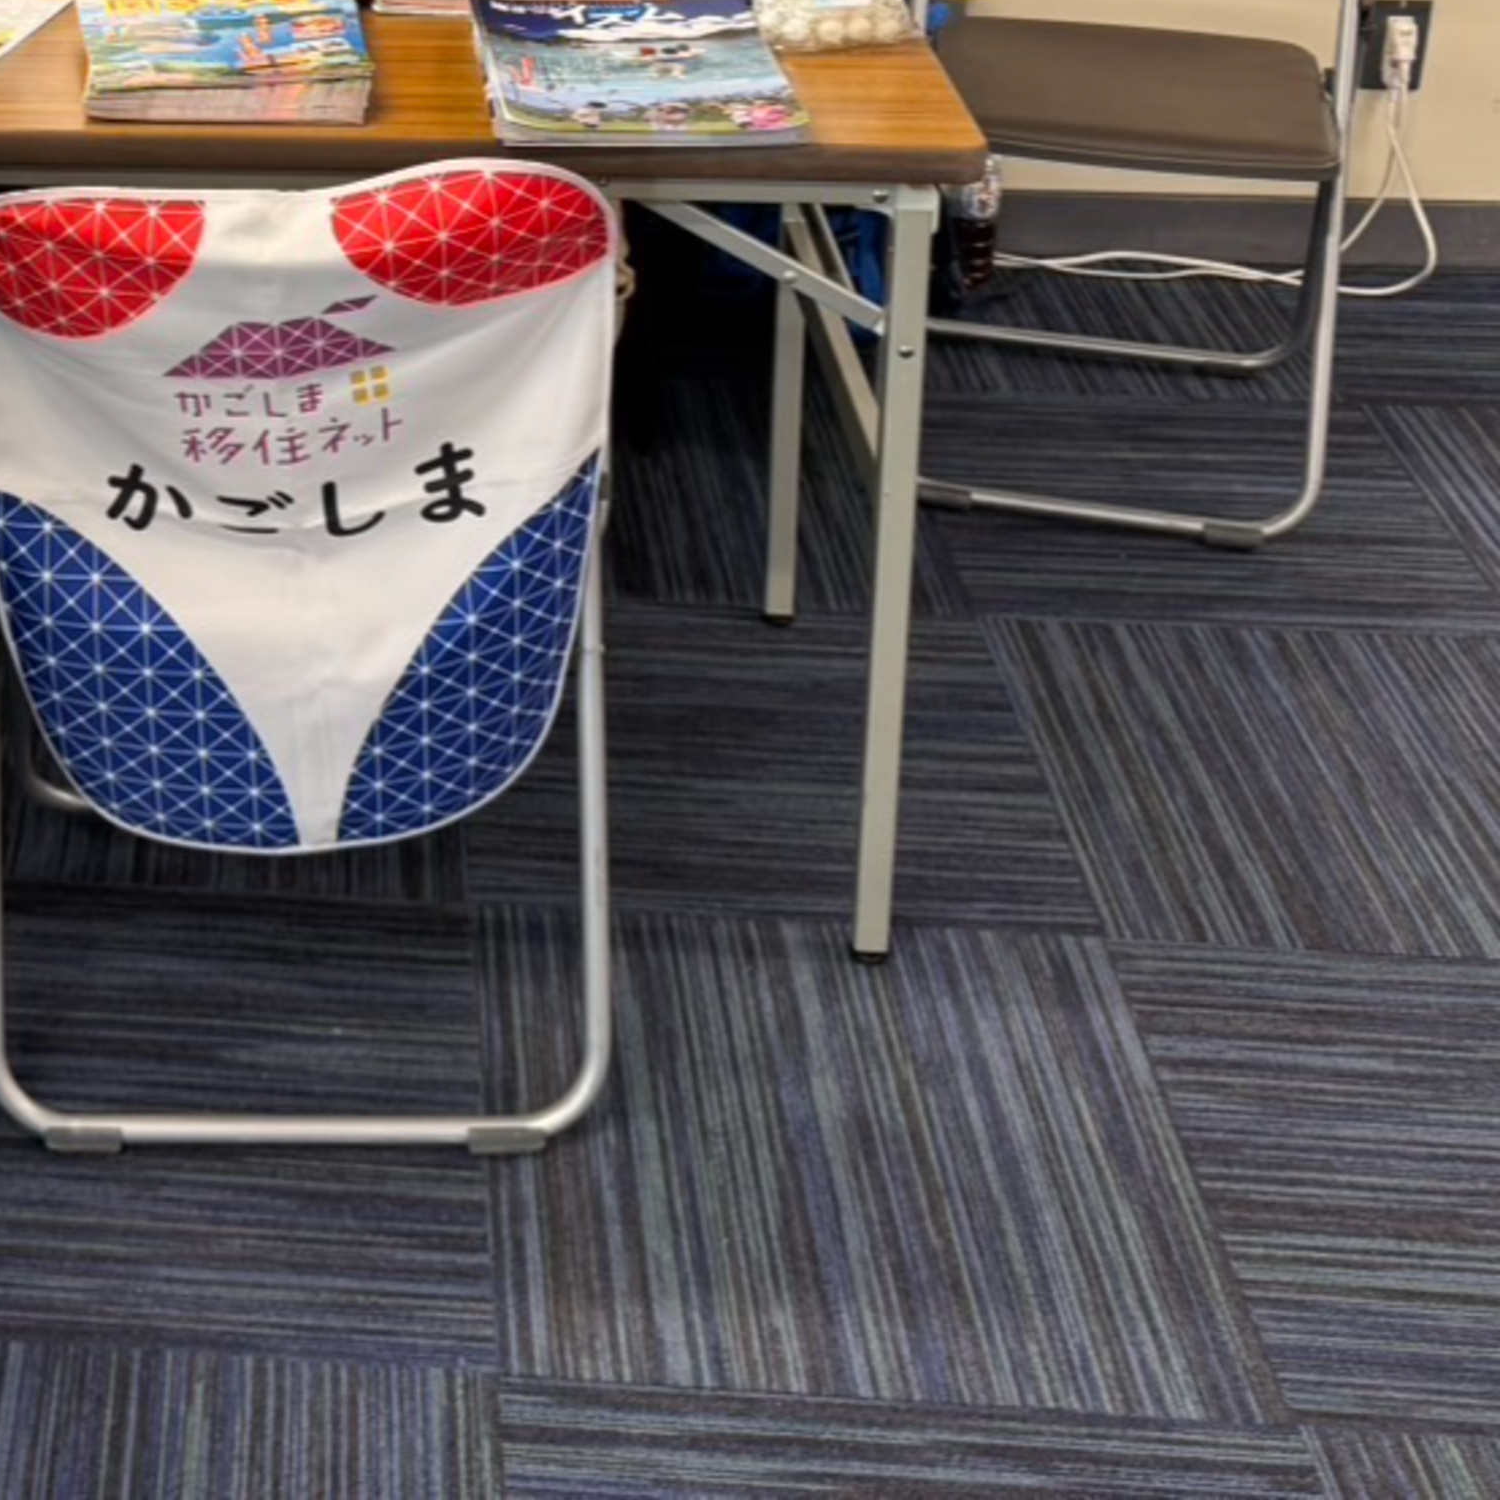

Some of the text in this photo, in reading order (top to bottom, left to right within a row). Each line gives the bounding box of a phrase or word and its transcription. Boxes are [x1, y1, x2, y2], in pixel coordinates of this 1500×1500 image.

[173, 383, 324, 419] かごしま
[181, 408, 405, 466] 移住ネット
[105, 442, 487, 538] かごしま
